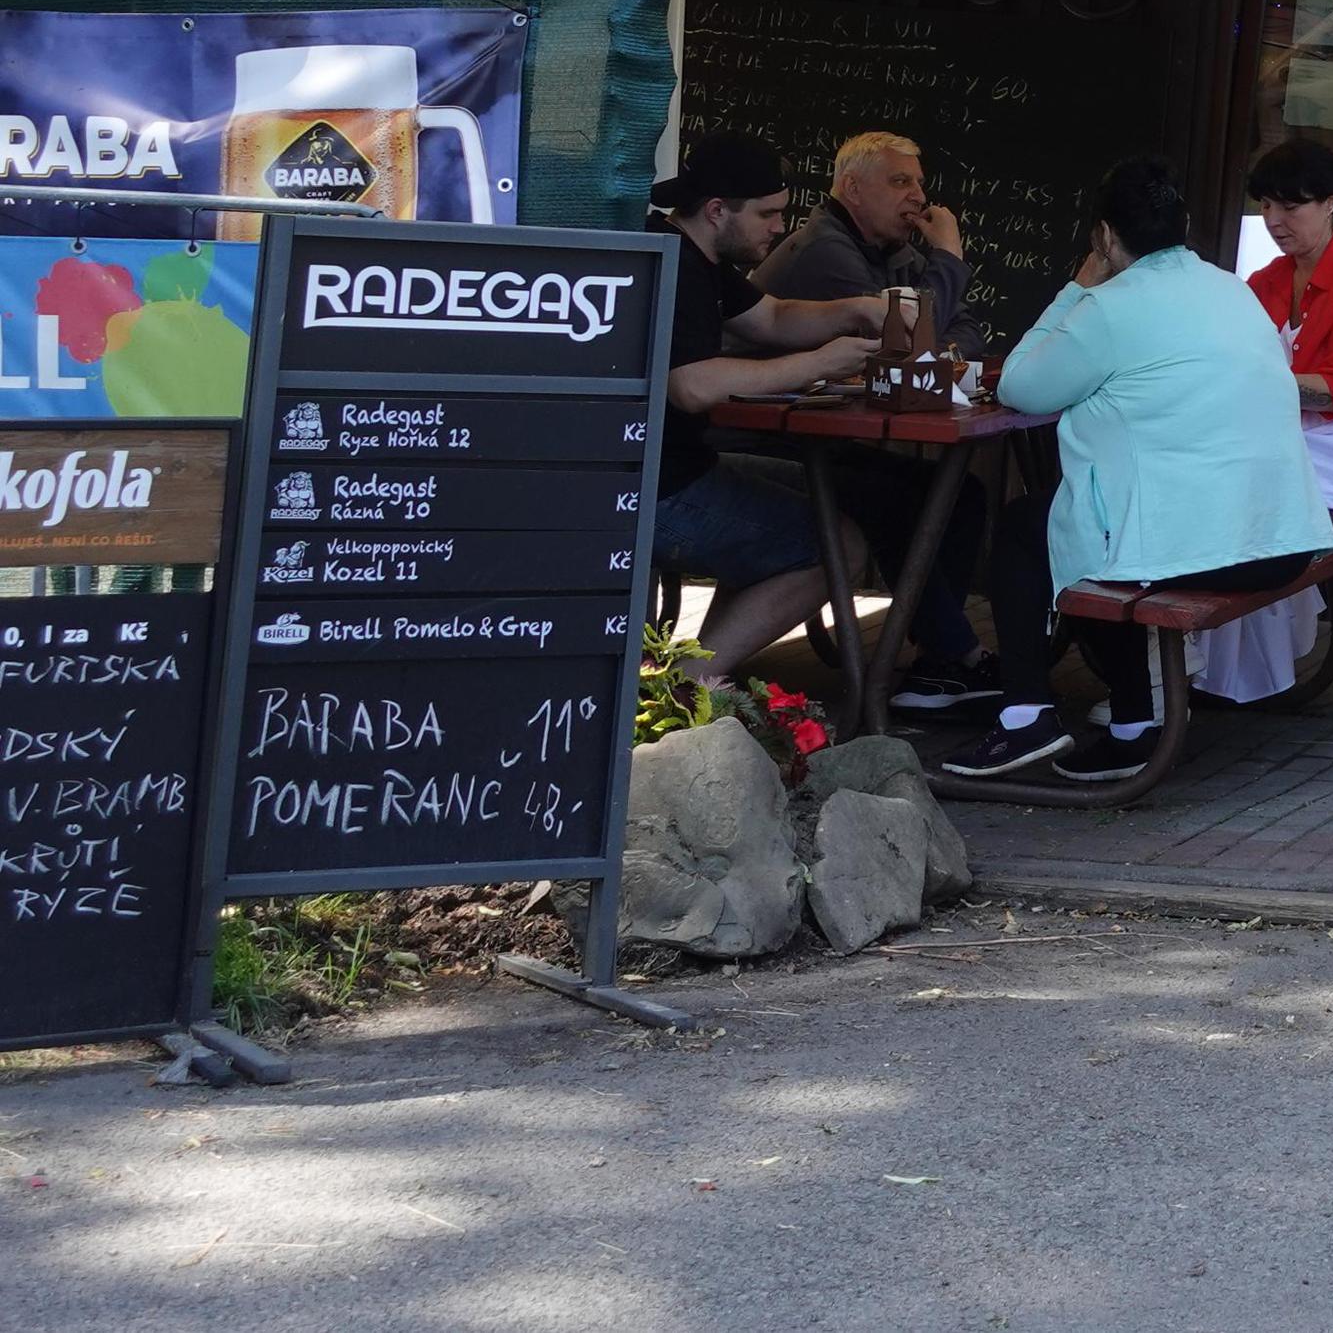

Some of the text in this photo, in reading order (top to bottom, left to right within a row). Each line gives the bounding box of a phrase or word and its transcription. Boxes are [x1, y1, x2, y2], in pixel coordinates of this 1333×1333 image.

[274, 168, 366, 187] BARABA
[303, 264, 634, 342] RADEGAST
[342, 400, 647, 442] Radegast Kč
[279, 438, 331, 451] RADEGAST
[339, 428, 472, 456] Ryze Hořká 12
[0, 450, 153, 527] kofola
[333, 473, 640, 512] Radegast Kč
[270, 509, 323, 521] RADEGAST
[330, 499, 432, 521] Rázná 10
[90, 534, 111, 547] CO
[326, 537, 455, 563] Velkopopovický
[262, 566, 315, 584] Kozel
[322, 550, 633, 584] Kozel 11 Kč
[63, 628, 90, 644] za
[120, 621, 149, 642] Kč
[263, 628, 306, 640] BIRELL
[319, 615, 628, 649] Birell Pomelo & Grep Kč
[247, 687, 447, 759] BARABA
